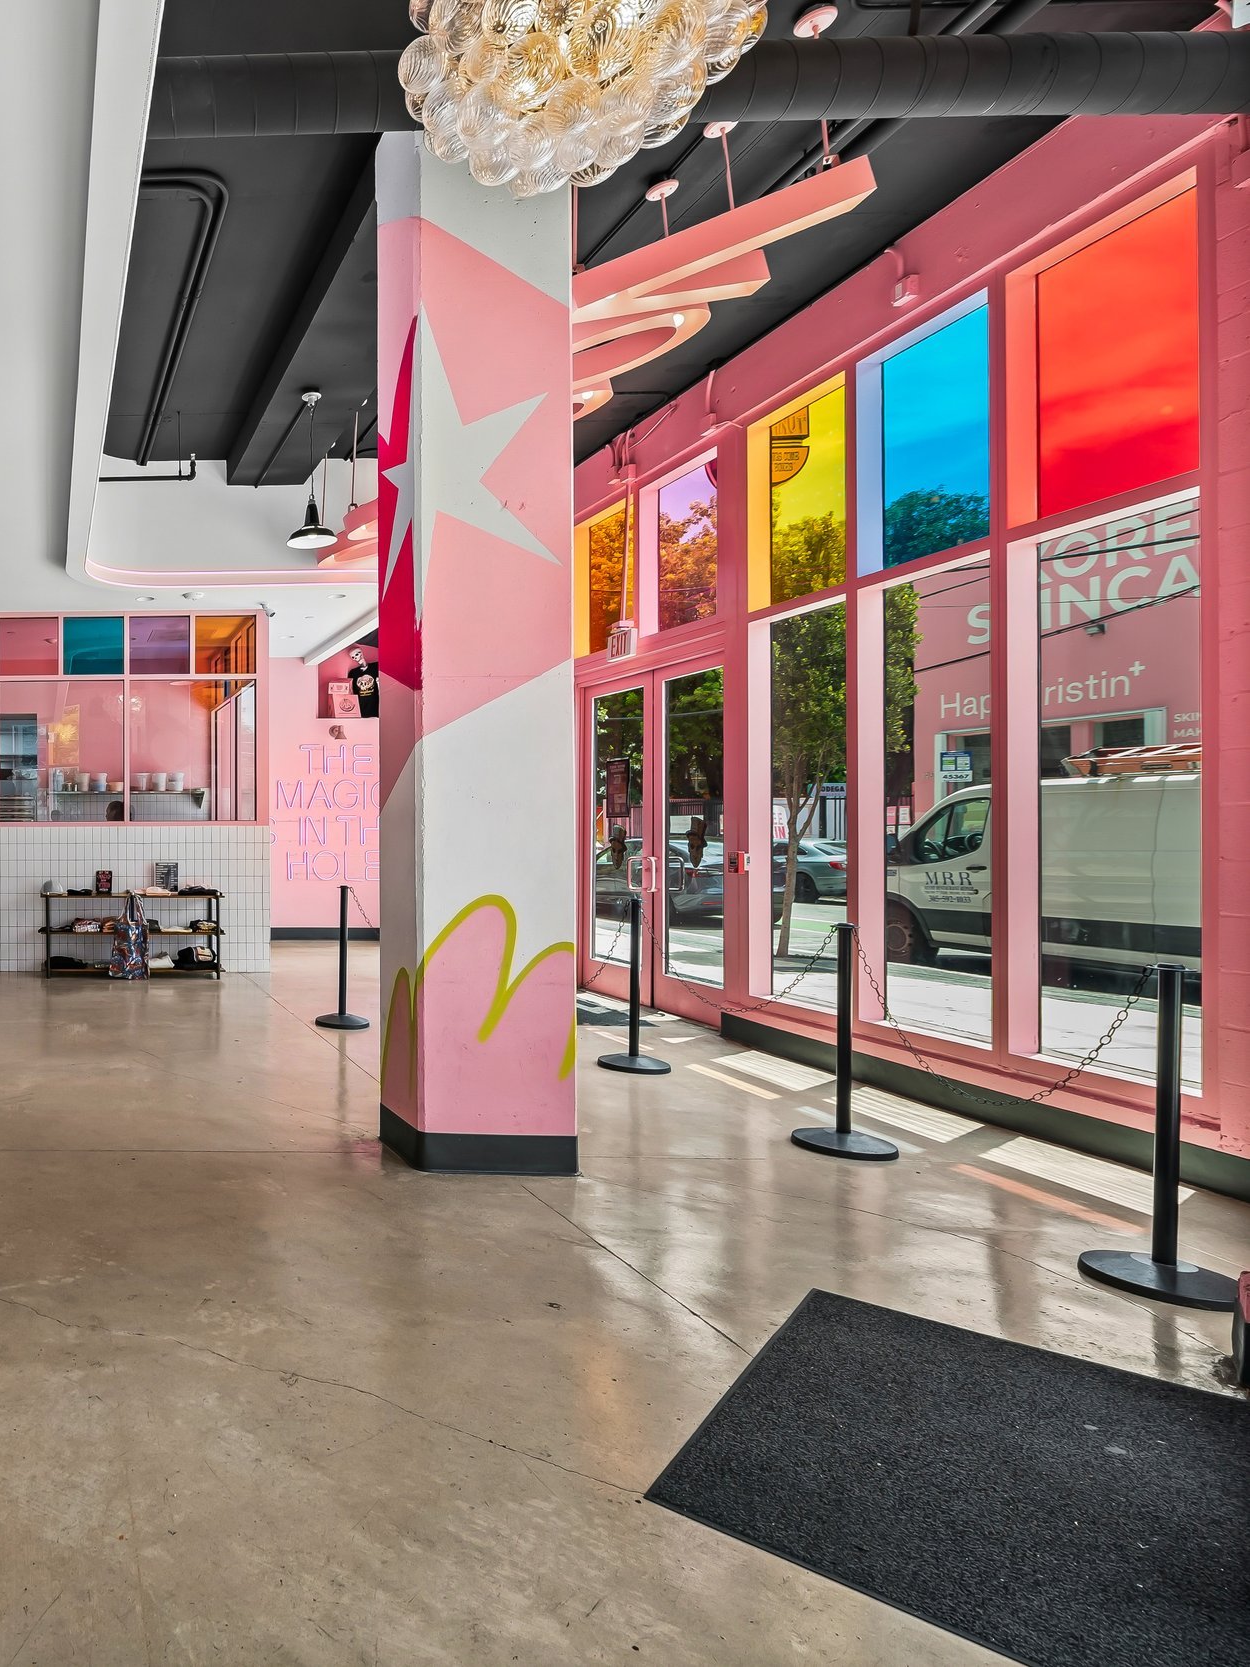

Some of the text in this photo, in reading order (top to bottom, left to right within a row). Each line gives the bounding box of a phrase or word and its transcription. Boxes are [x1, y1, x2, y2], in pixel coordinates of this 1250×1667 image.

[611, 631, 628, 657] EXIT
[1044, 661, 1146, 706] ristin+
[299, 743, 374, 776] THE
[299, 815, 327, 846] IN
[336, 815, 380, 846] TH
[286, 851, 380, 881] HOLE
